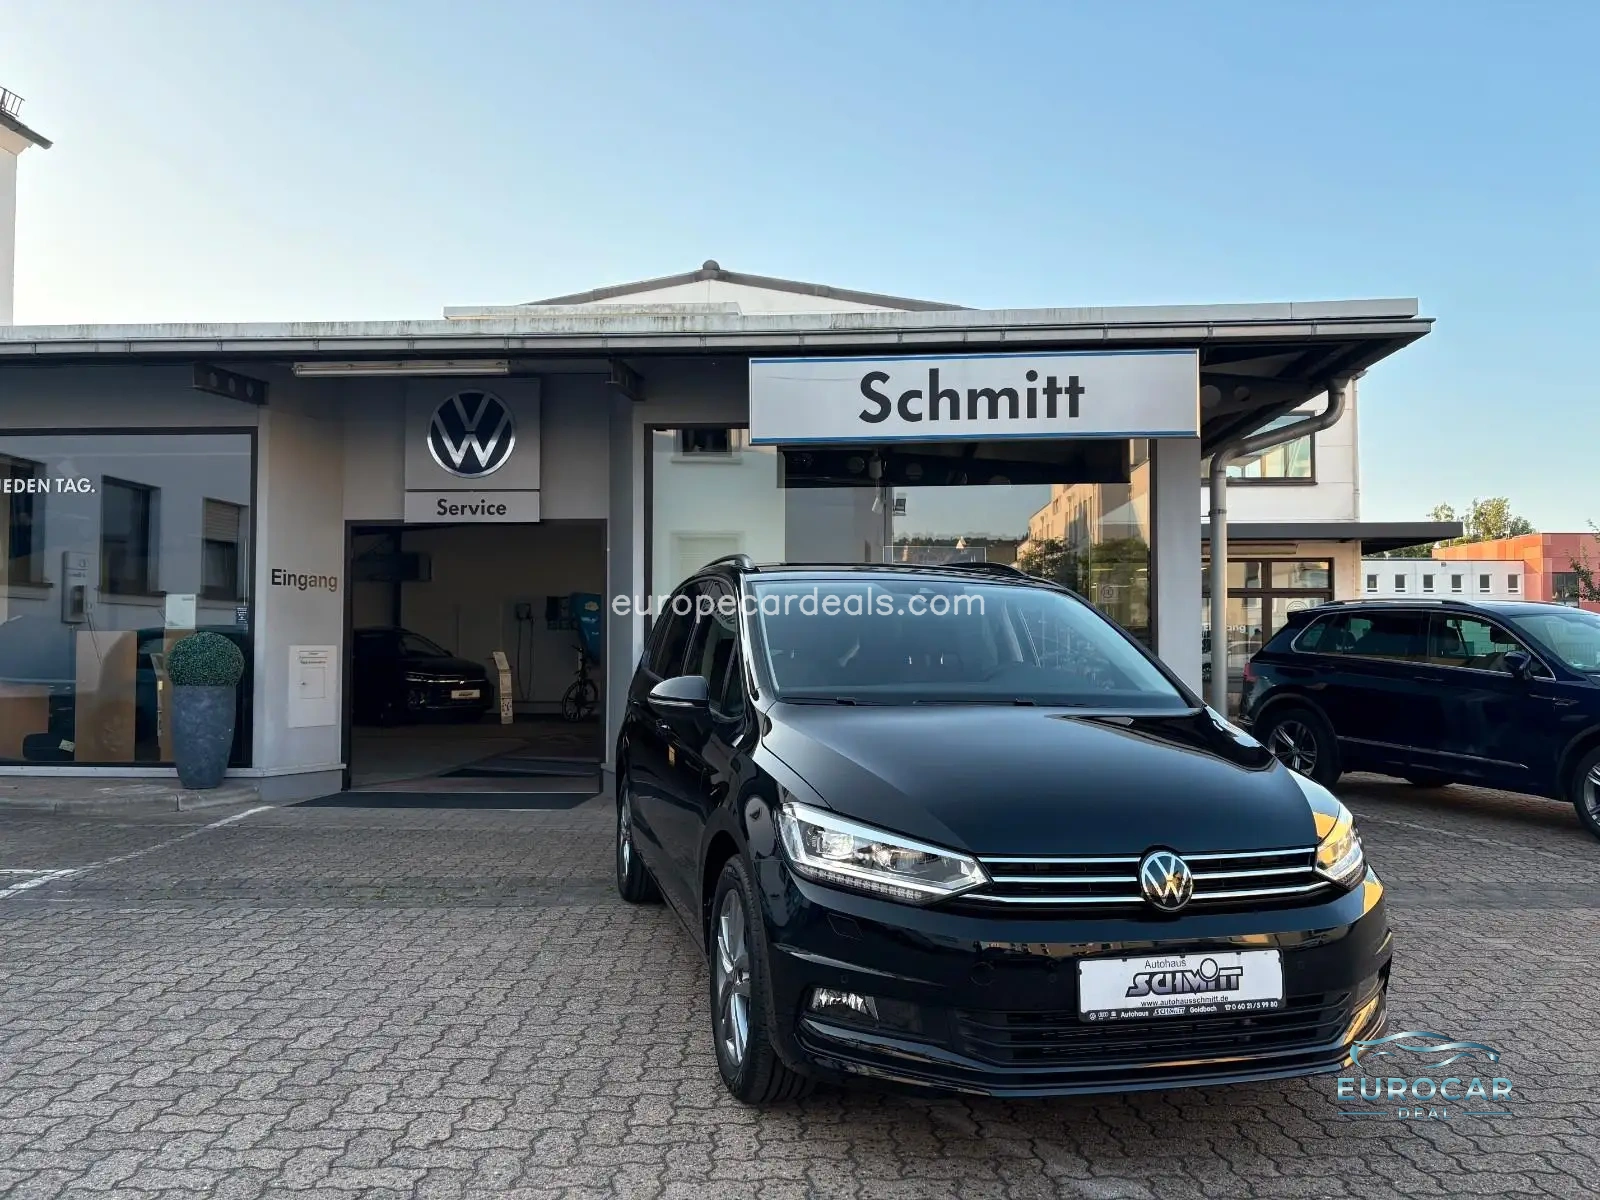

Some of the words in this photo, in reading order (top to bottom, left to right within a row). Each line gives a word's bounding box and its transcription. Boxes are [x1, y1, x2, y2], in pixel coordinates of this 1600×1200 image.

[858, 367, 1086, 424] Schmitt
[426, 388, 516, 479] VW
[55, 477, 96, 494] TAG.
[436, 498, 507, 516] Service
[270, 568, 338, 592] Eingang
[1141, 850, 1193, 912] VW
[1144, 957, 1188, 970] Autohaus
[1141, 995, 1229, 1007] www.autohausschmitt.de
[1189, 1005, 1218, 1014] Goldbach
